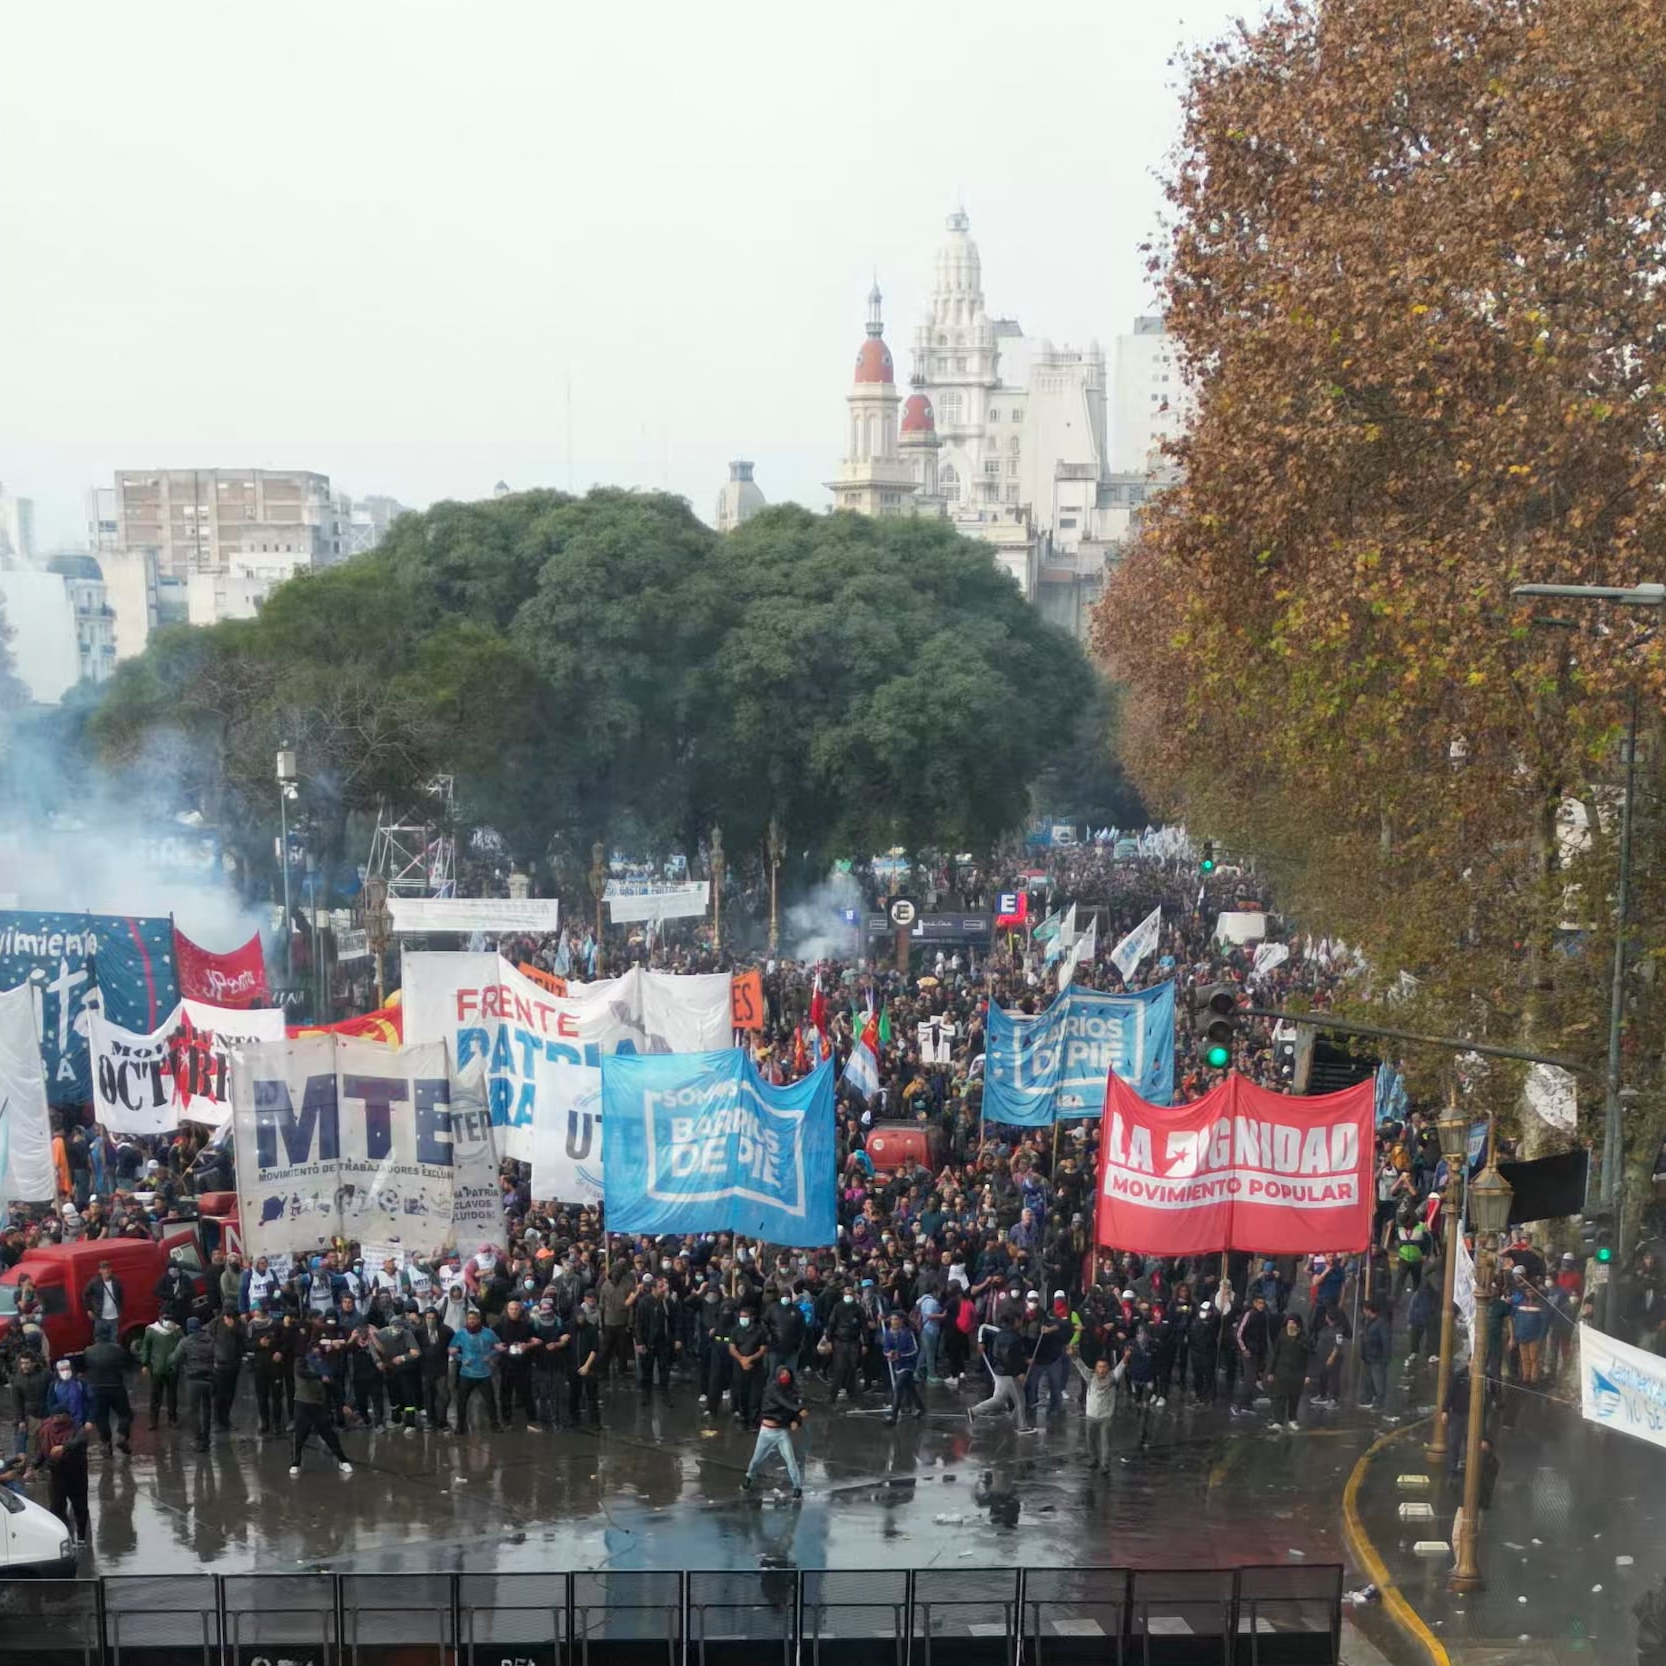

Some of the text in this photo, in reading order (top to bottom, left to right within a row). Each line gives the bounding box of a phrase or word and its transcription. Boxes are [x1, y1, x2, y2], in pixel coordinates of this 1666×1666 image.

[456, 985, 581, 1037] FRENTE
[1068, 1041, 1124, 1069] PIE
[253, 1073, 454, 1170] MTE
[671, 1107, 780, 1157] BARRIOS
[1109, 1112, 1359, 1178] LA DIGNIDAD
[322, 1164, 336, 1174] DE
[671, 1140, 782, 1187] DE PIE
[1113, 1174, 1352, 1202] MOVIMIENTO POPULAR
